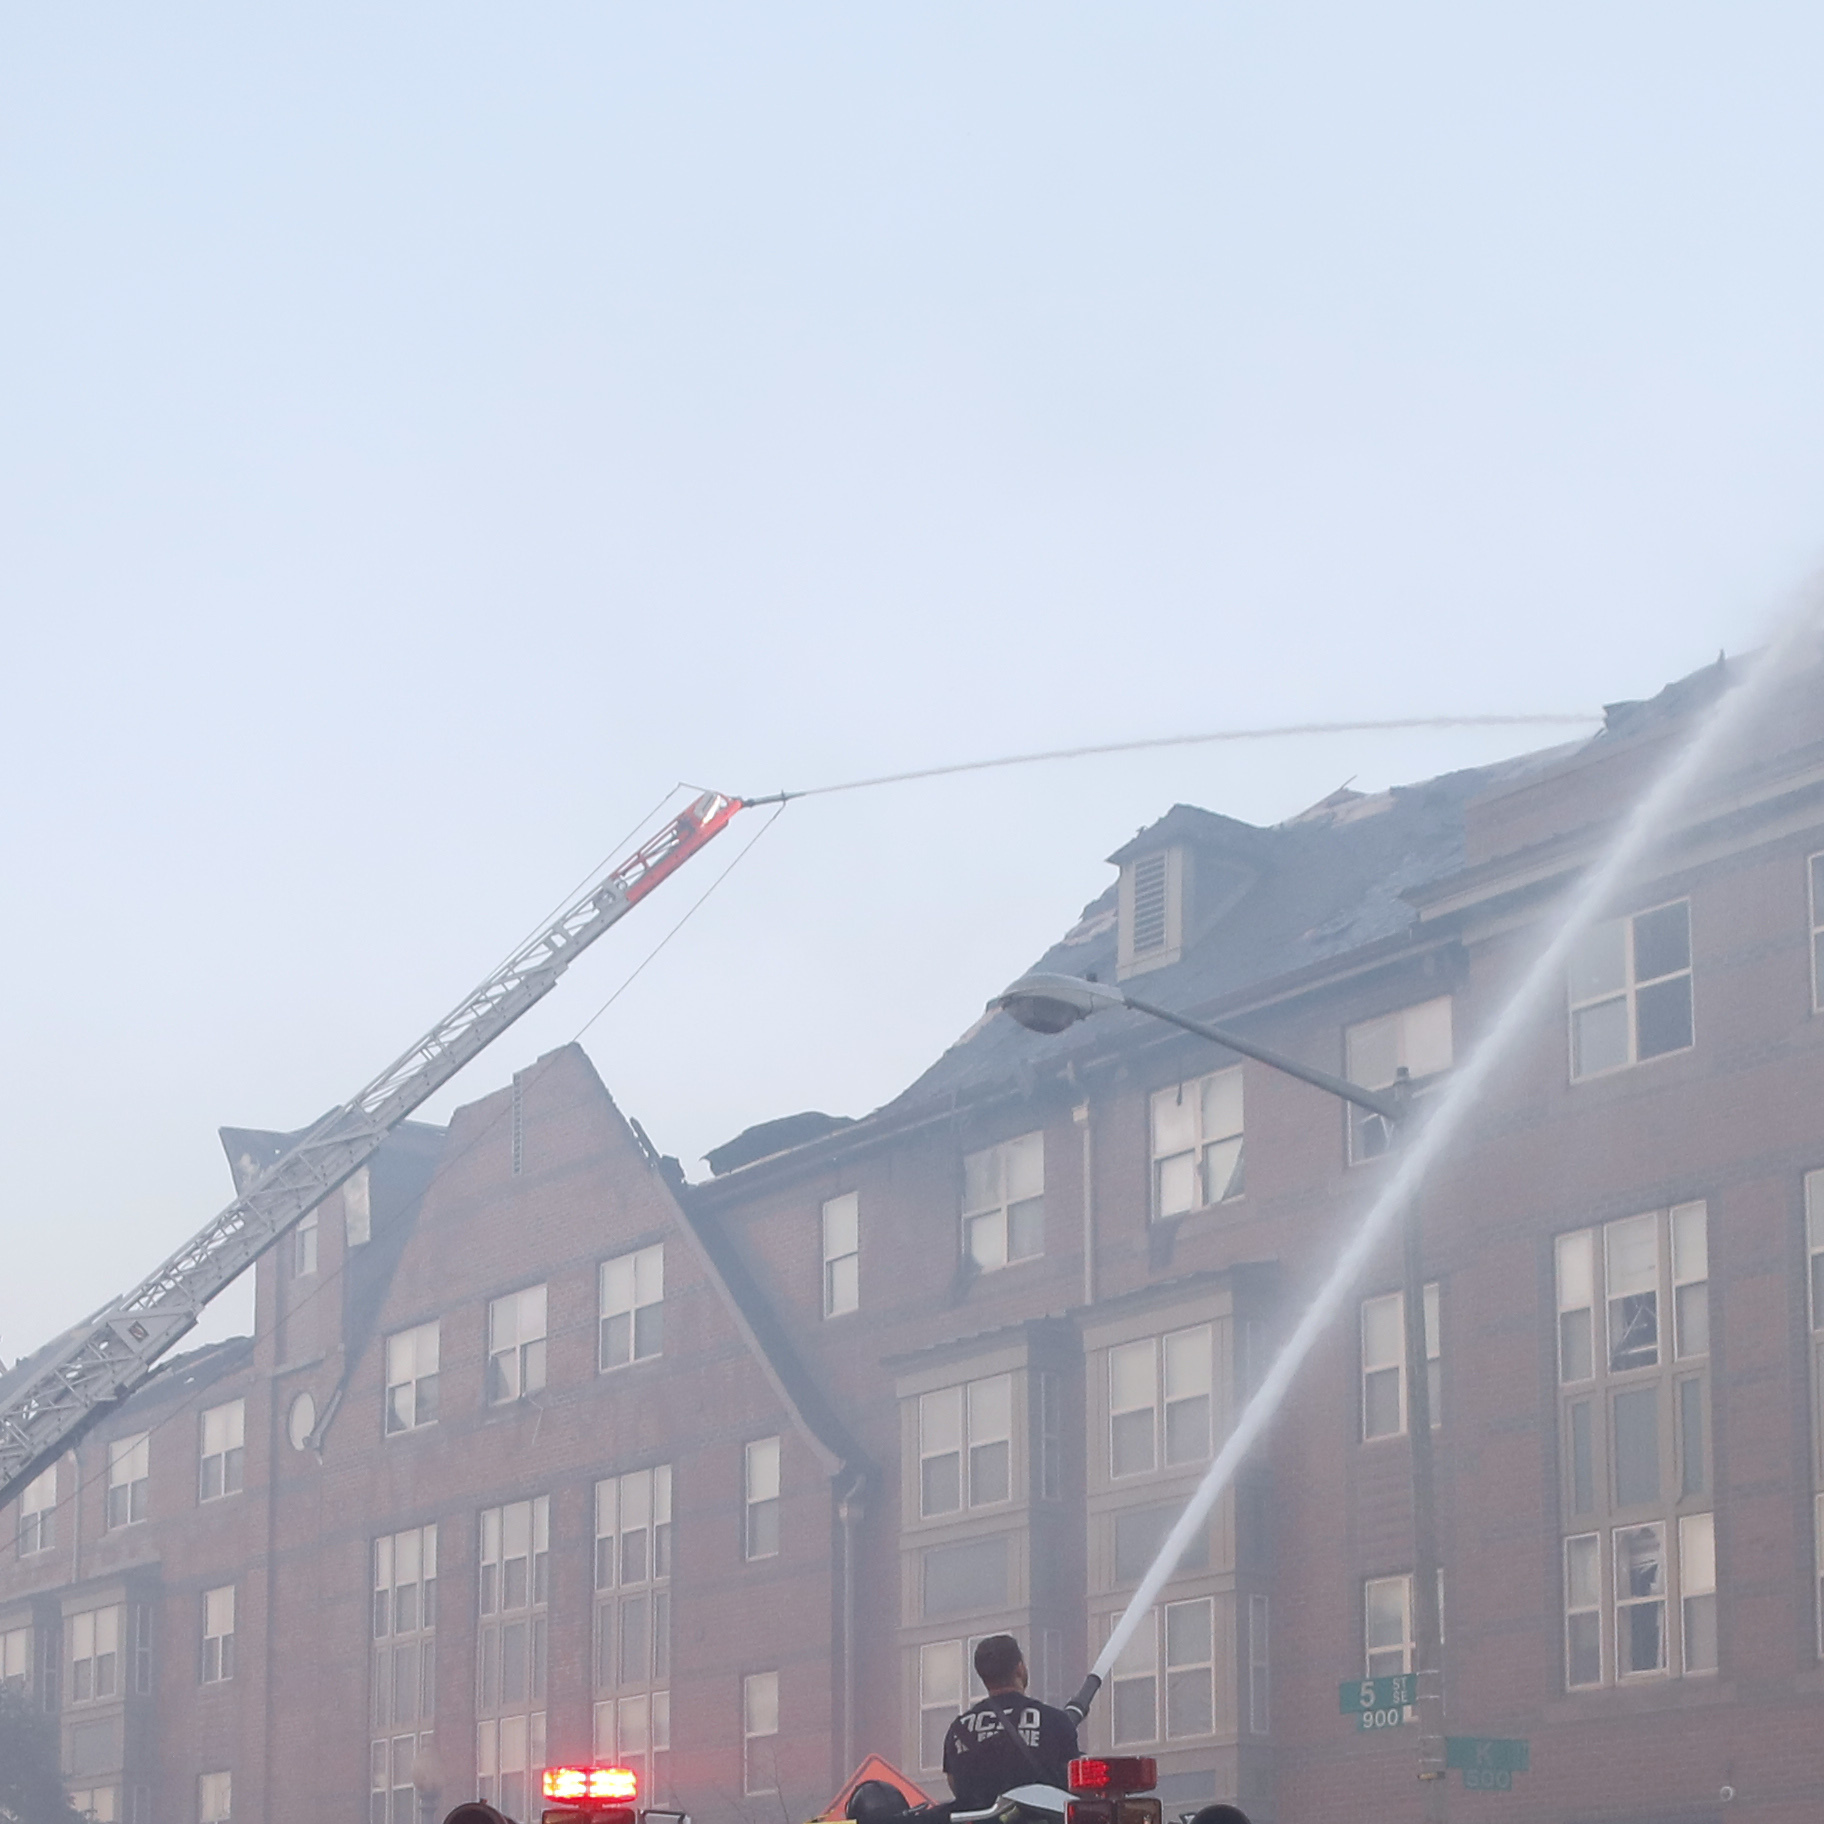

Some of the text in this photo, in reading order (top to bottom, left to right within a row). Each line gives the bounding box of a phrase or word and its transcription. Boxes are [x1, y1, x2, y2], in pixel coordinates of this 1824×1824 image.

[1392, 1677, 1408, 1691] ST
[1359, 1680, 1376, 1708] 5
[1392, 1690, 1408, 1704] SE
[1362, 1708, 1399, 1729] 900
